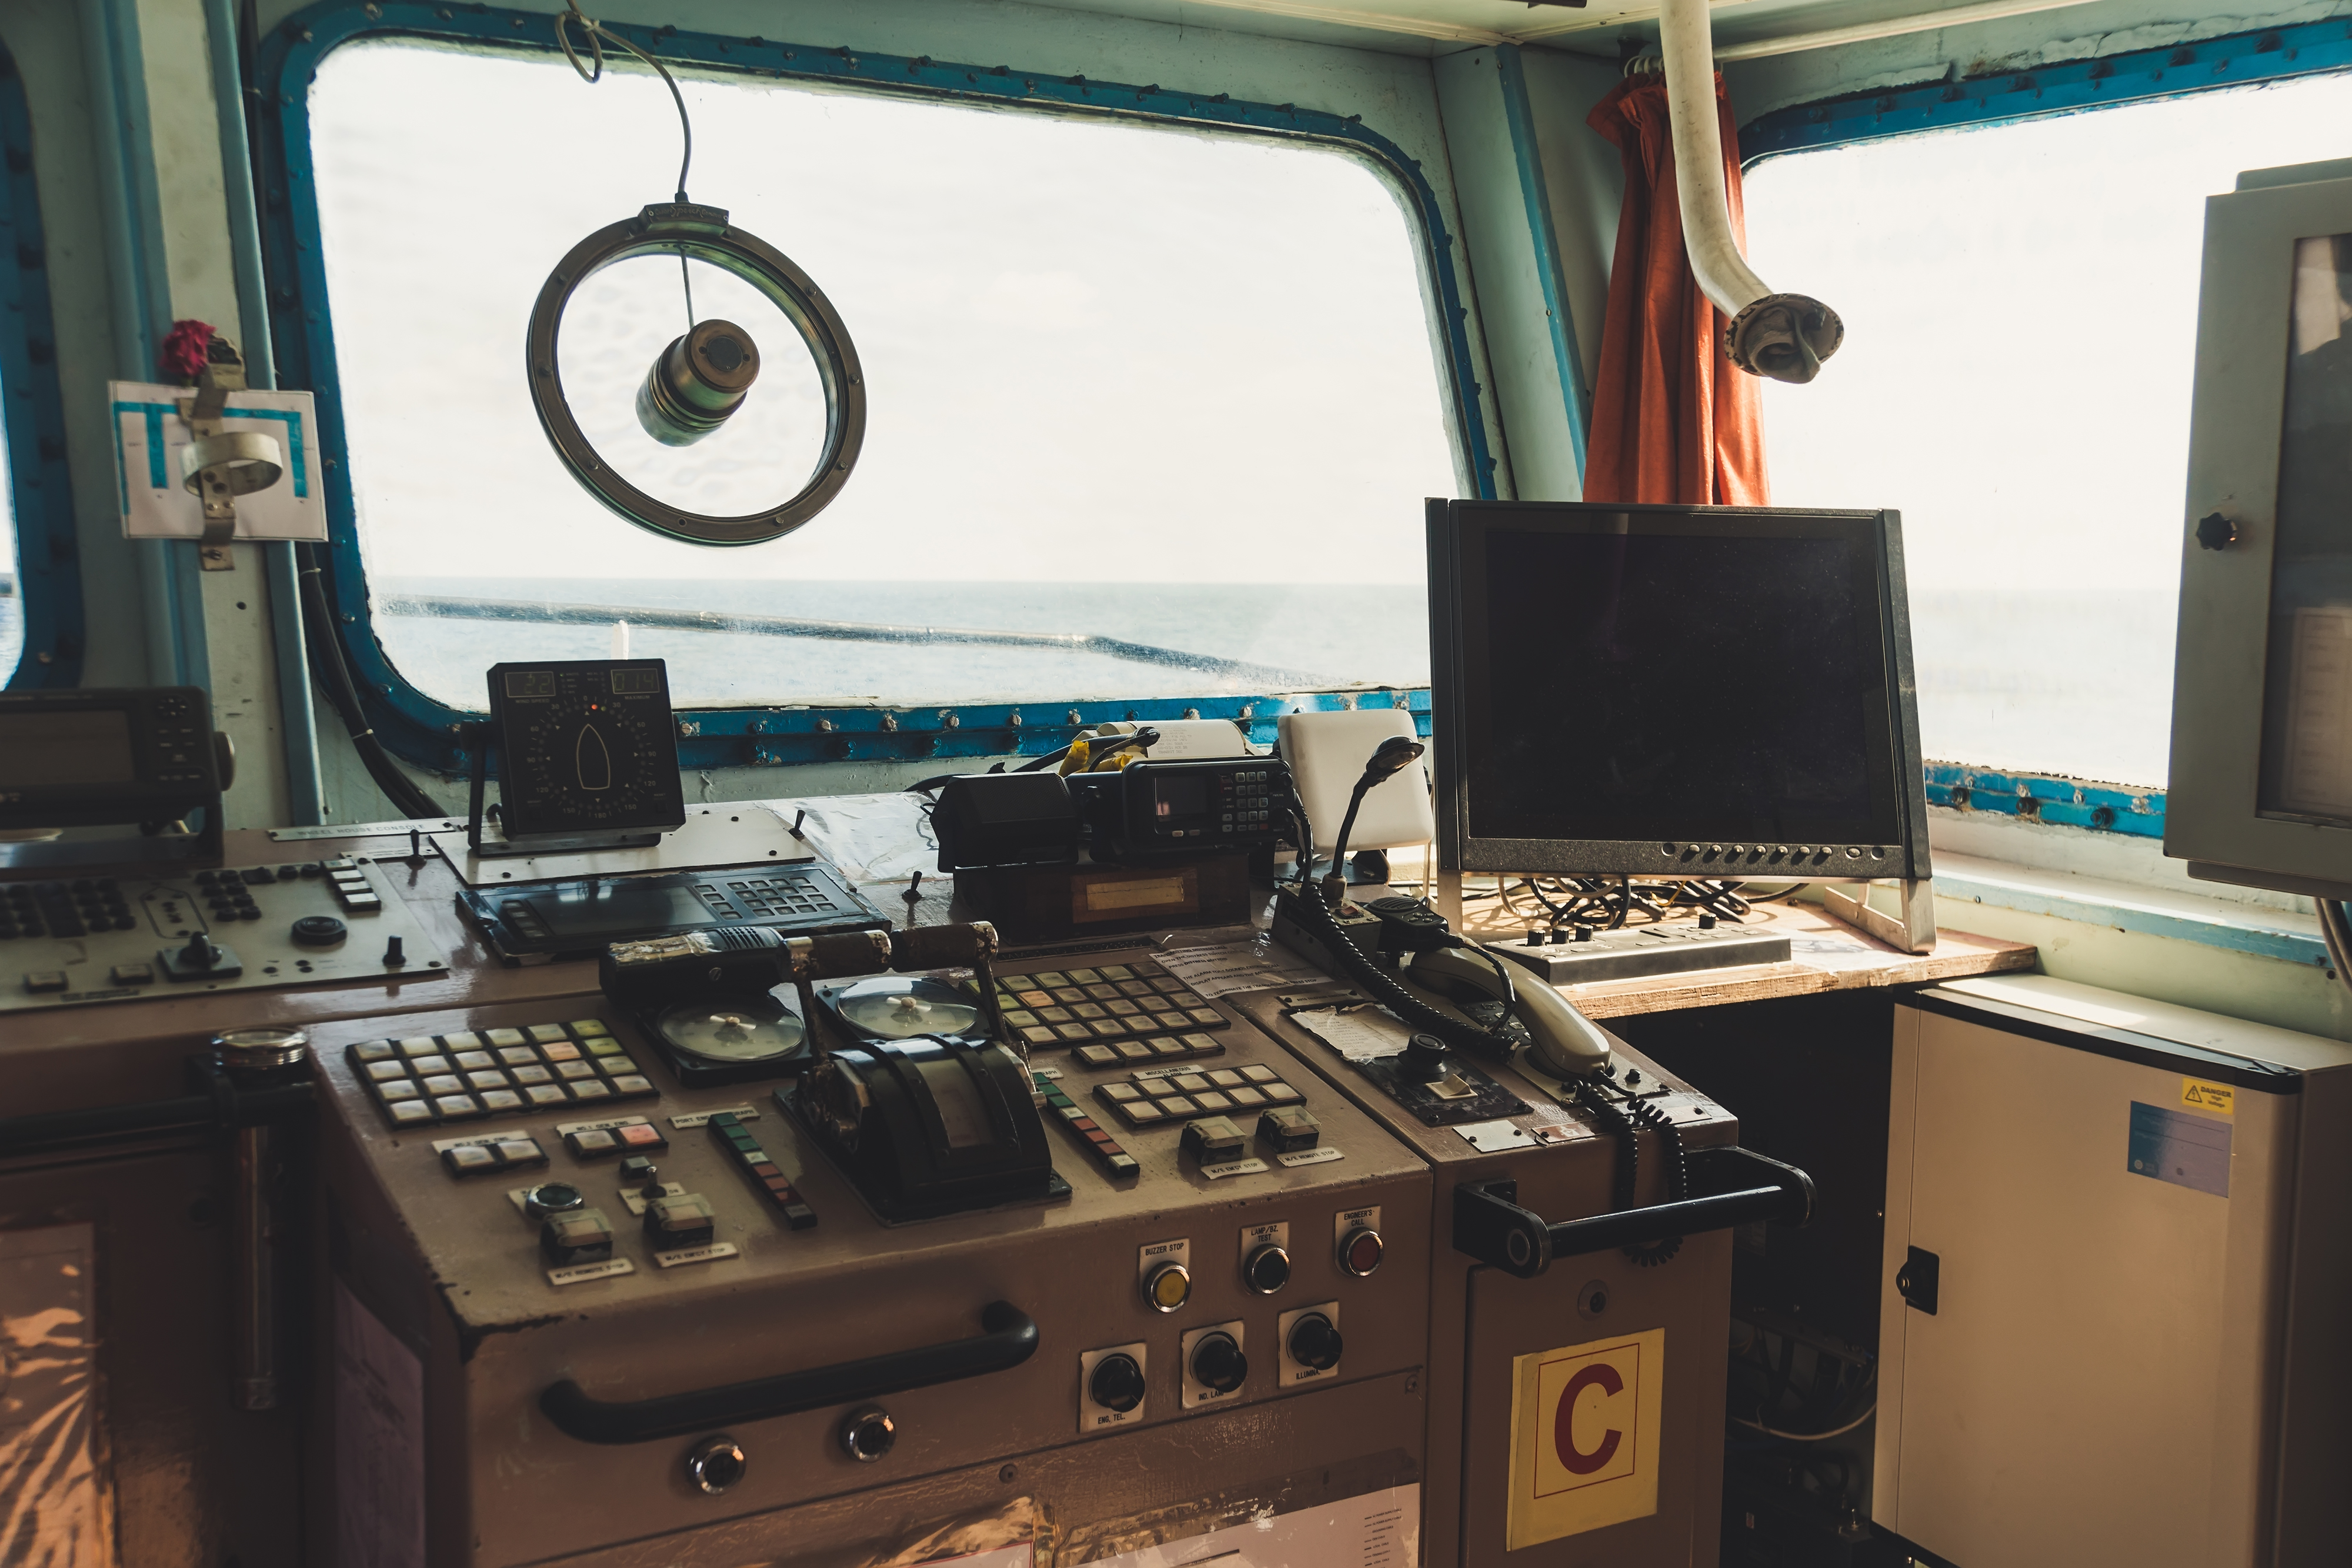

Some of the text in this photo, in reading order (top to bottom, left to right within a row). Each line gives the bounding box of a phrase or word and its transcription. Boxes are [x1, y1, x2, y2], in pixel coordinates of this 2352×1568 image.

[1002, 950, 1042, 959] MMSI
[1154, 948, 1192, 958] TRANSMITTING
[1190, 978, 1212, 986] DISPLAY
[1213, 986, 1242, 996] TERMINATE
[1145, 1066, 1191, 1076] MISCELLANEOUS
[2200, 1086, 2232, 1098] DANGER
[1344, 1209, 1373, 1220] ENGINEER'S
[1351, 1219, 1365, 1227] CALL
[1251, 1225, 1279, 1236] LAMP/BZ.
[1258, 1233, 1272, 1242] TEST
[1145, 1242, 1184, 1256] BUZZER STOP
[1296, 1369, 1320, 1380] ILLUMINA.
[1199, 1393, 1209, 1401] IND.
[1097, 1413, 1126, 1424] ENG. TEL.
[1554, 1363, 1624, 1475] C
